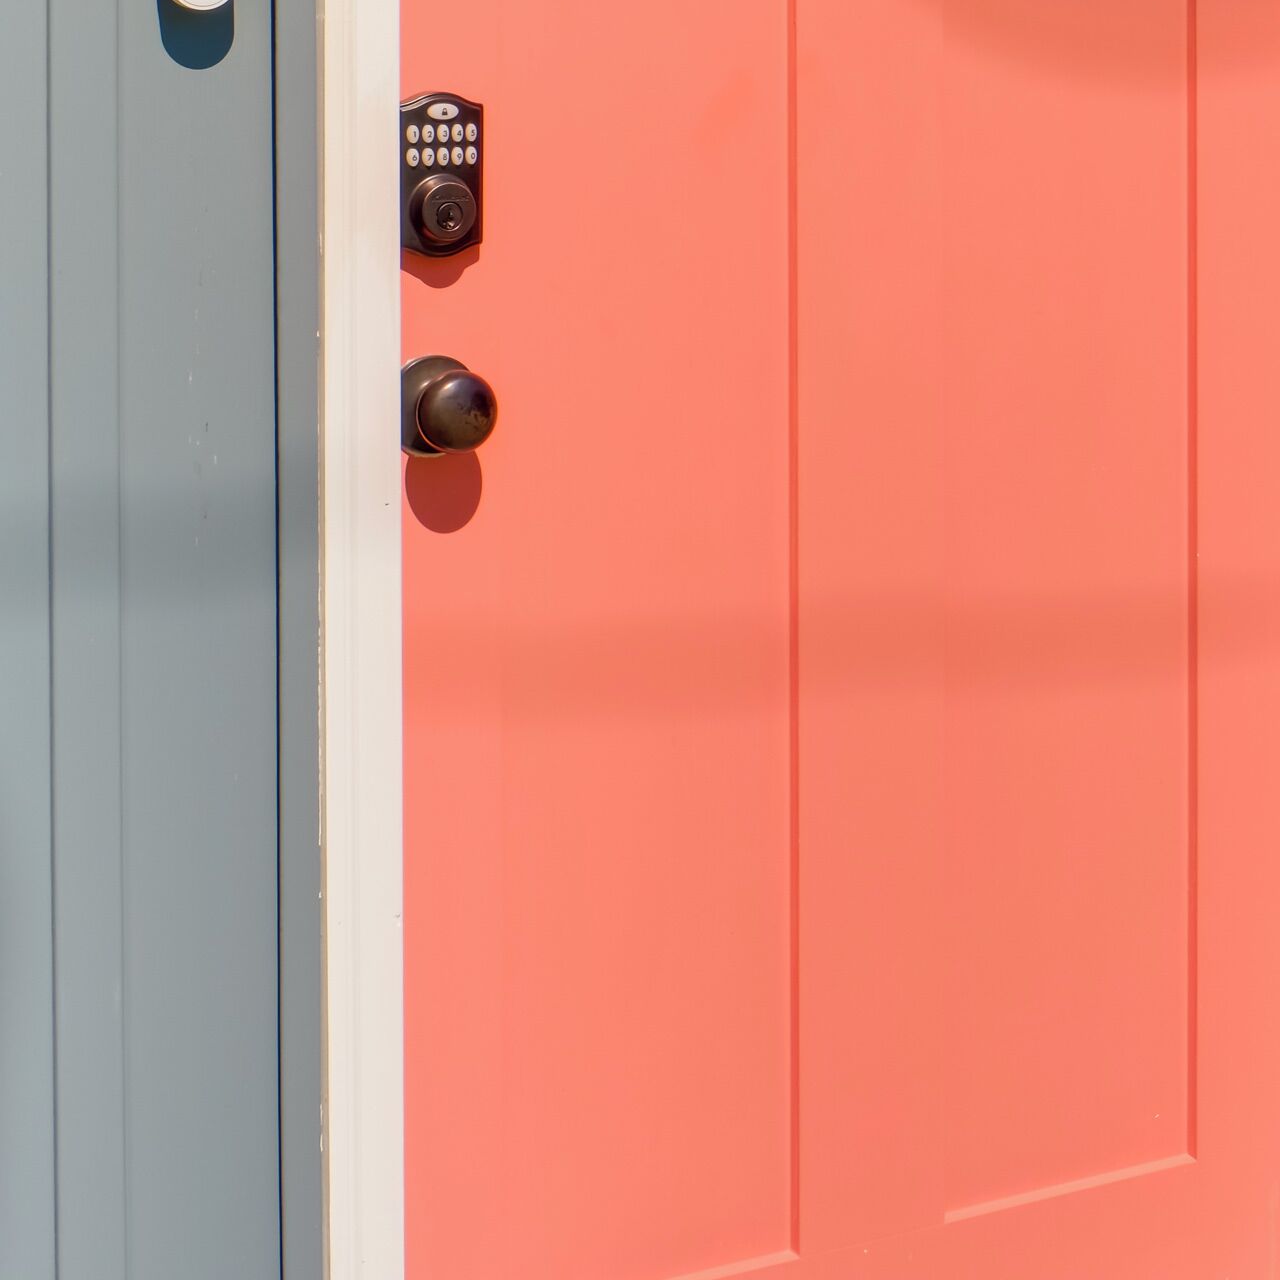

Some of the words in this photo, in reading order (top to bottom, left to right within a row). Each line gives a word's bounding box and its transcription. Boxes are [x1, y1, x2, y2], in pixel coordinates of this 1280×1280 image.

[427, 130, 433, 138] 2
[442, 130, 448, 138] 3
[457, 129, 462, 137] 4
[471, 129, 476, 137] 5
[412, 154, 418, 162] 6
[442, 153, 448, 161] 8
[457, 152, 462, 160] 9
[470, 152, 476, 160] 0
